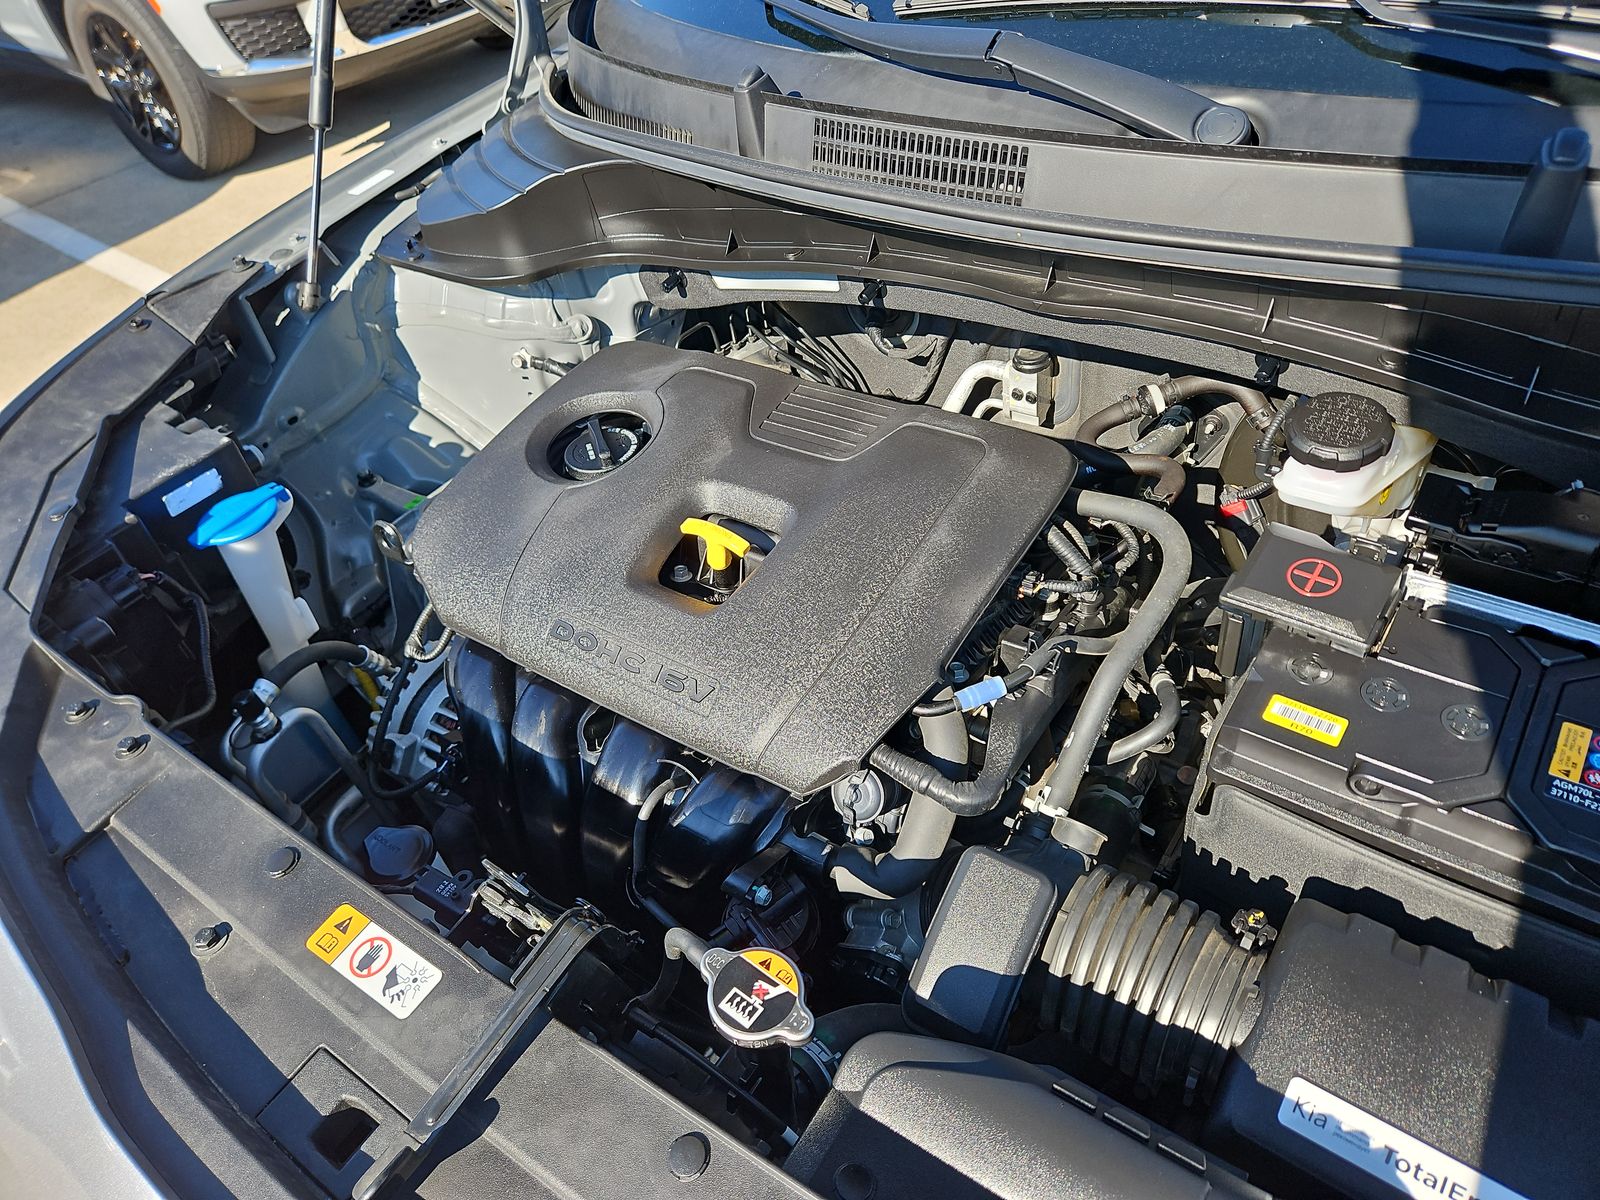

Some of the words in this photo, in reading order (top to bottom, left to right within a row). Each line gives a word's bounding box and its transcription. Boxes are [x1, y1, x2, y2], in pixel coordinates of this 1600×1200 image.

[550, 618, 646, 675] DOHC
[650, 664, 716, 704] 16V
[1292, 1096, 1329, 1130] Kia
